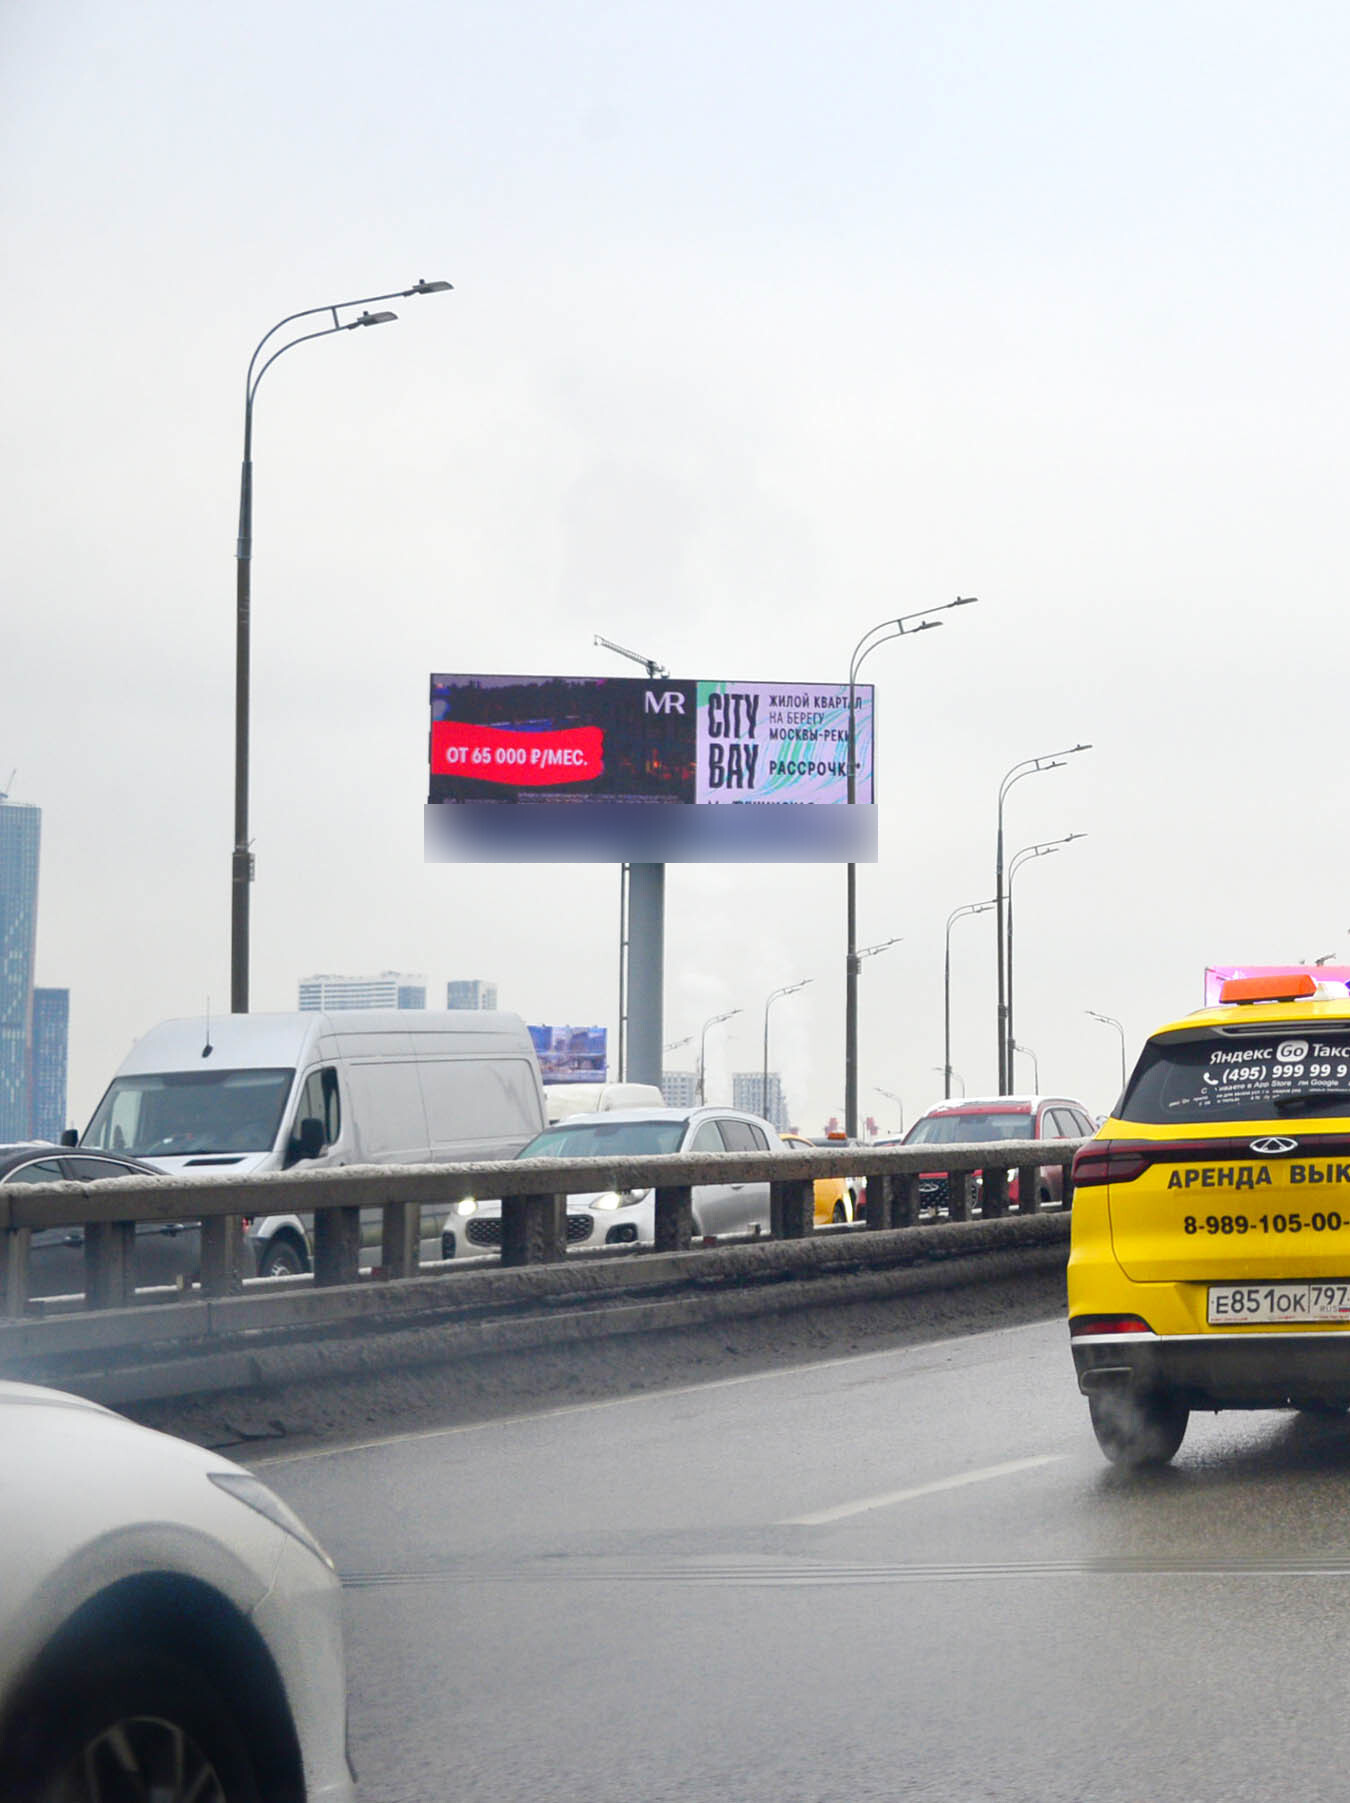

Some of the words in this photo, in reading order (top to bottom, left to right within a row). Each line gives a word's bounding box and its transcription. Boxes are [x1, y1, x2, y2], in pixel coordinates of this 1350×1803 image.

[645, 691, 686, 714] MR
[768, 693, 809, 708] ЖИЛОЙ
[708, 692, 760, 739] CITY
[769, 712, 784, 724] НА
[787, 712, 824, 725] БЕРЕГУ
[446, 747, 469, 763] ОТ
[472, 747, 491, 764] 65
[496, 748, 527, 765] 000
[709, 743, 760, 789] BAY
[1209, 1047, 1273, 1065] Яндекс
[1279, 1043, 1305, 1058] Go
[1222, 1065, 1267, 1084] (495)
[1272, 1064, 1304, 1078] 999
[1309, 1064, 1331, 1077] 99
[1253, 1081, 1269, 1089] App
[1271, 1079, 1292, 1087] Store
[1310, 1079, 1339, 1087] Google
[1168, 1166, 1272, 1190] АРЕНДА
[1311, 1286, 1348, 1306] 797
